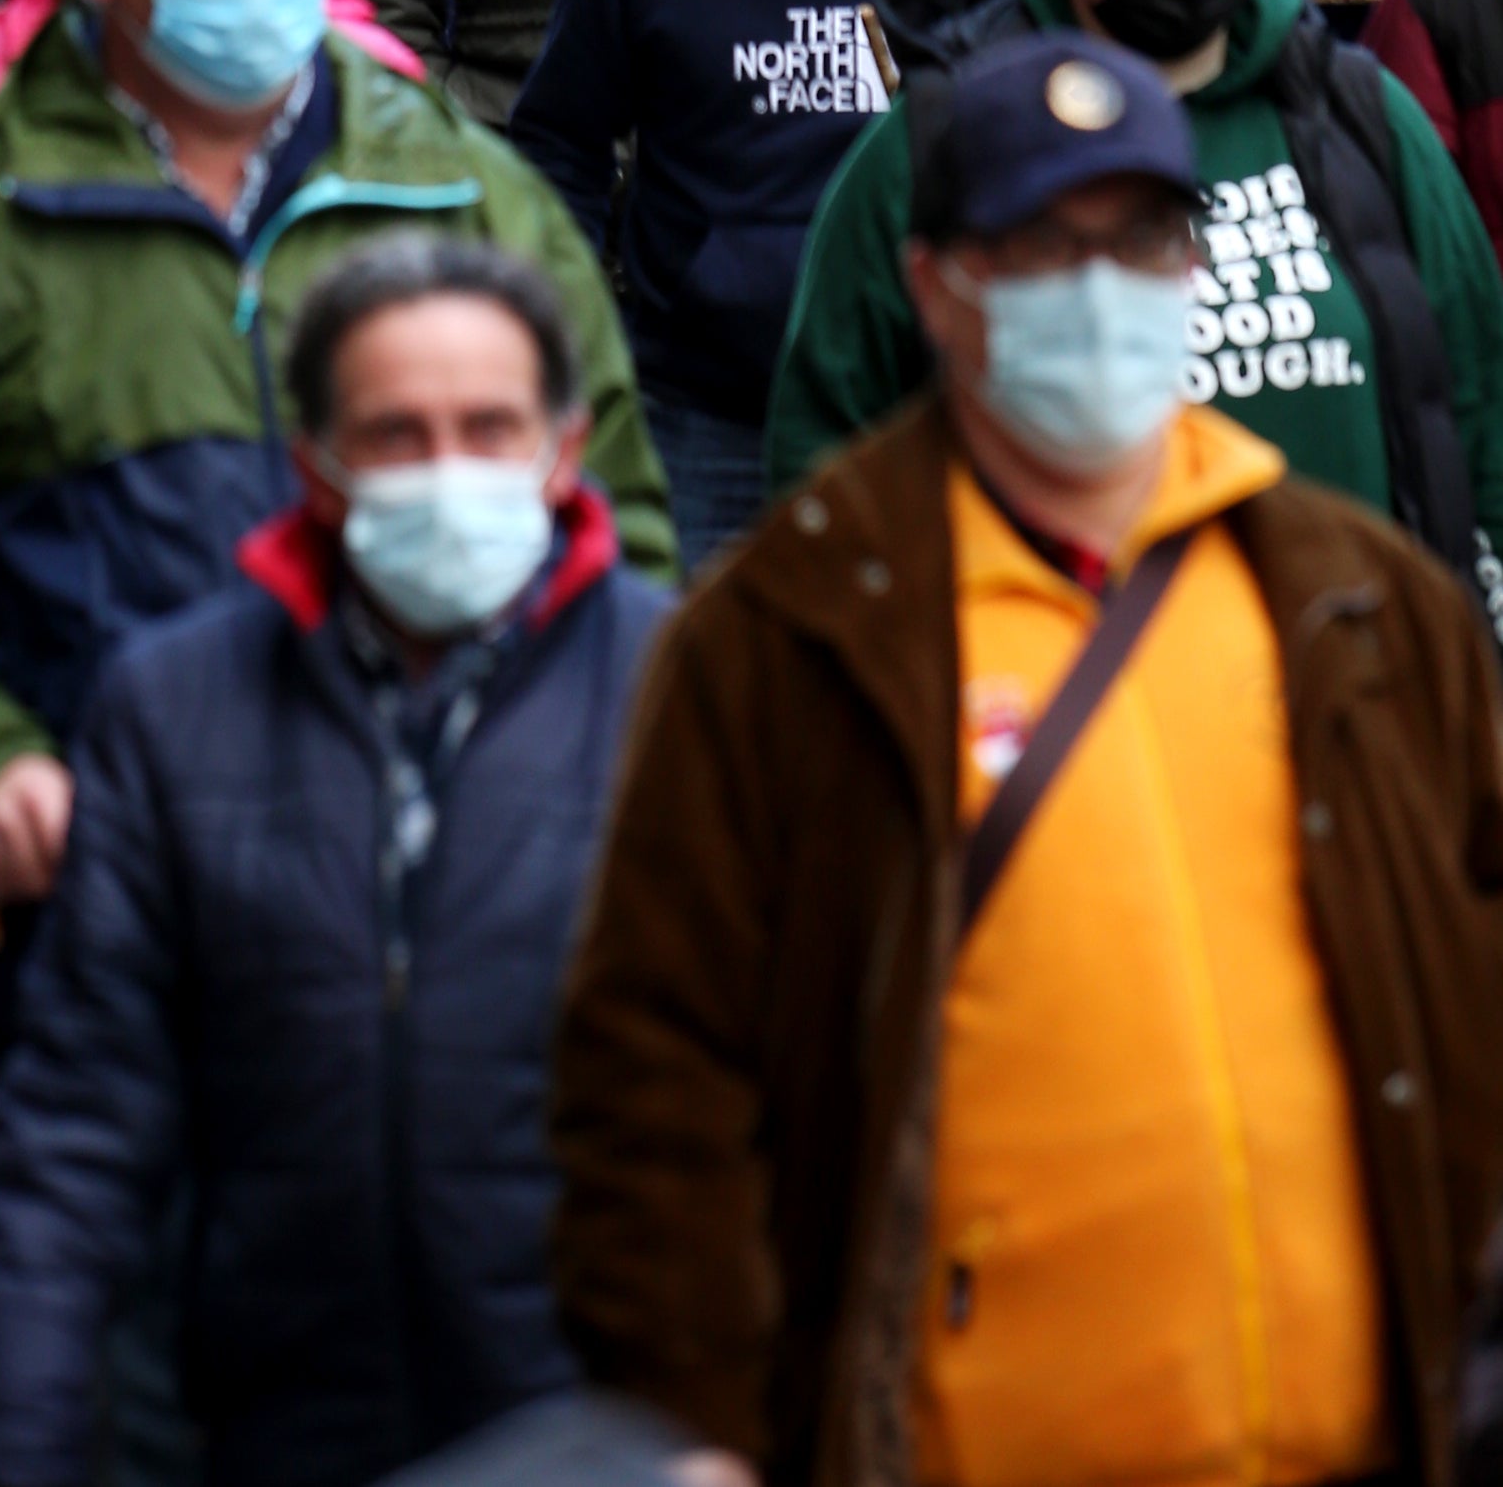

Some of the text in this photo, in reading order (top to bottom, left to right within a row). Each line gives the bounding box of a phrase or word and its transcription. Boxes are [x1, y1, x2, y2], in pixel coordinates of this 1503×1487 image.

[786, 5, 855, 45] THE
[733, 40, 855, 82] NORTH
[768, 78, 855, 114] FACE
[1266, 248, 1333, 295] IS
